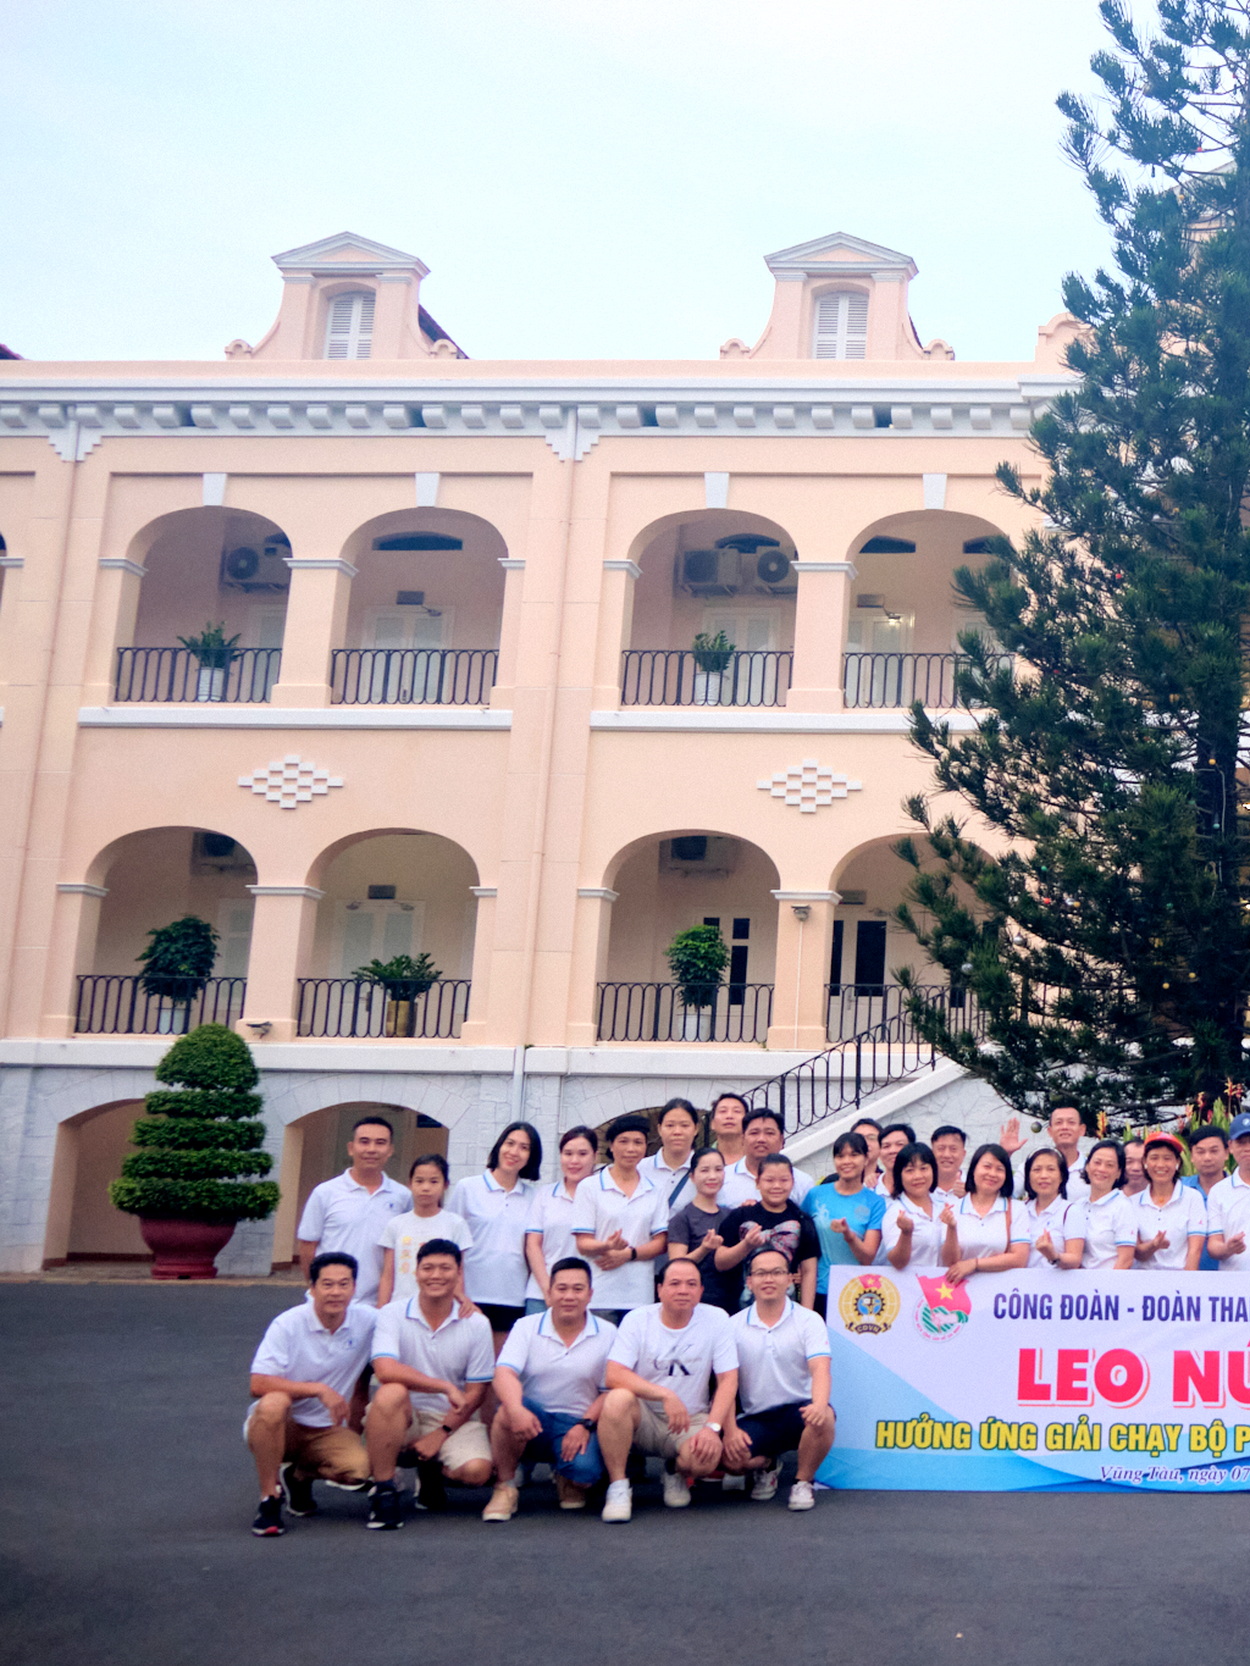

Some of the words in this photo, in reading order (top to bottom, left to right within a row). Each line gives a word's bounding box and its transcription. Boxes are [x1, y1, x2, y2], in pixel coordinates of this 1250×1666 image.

[993, 1288, 1052, 1321] CÔNG
[1060, 1289, 1120, 1322] ĐOÀN
[1142, 1290, 1201, 1323] ĐOÀN
[1017, 1347, 1150, 1409] LEO
[875, 1412, 972, 1450] HƯỞNG
[979, 1416, 1039, 1451] ỨNG
[1045, 1415, 1102, 1451] GIẢI
[1109, 1423, 1183, 1458] CHẠY
[1189, 1419, 1228, 1458] BỘ
[1100, 1466, 1143, 1483] Vũng
[1148, 1466, 1184, 1482] Tàu,
[1189, 1466, 1228, 1483] ngày
[1231, 1466, 1250, 1481] 07
